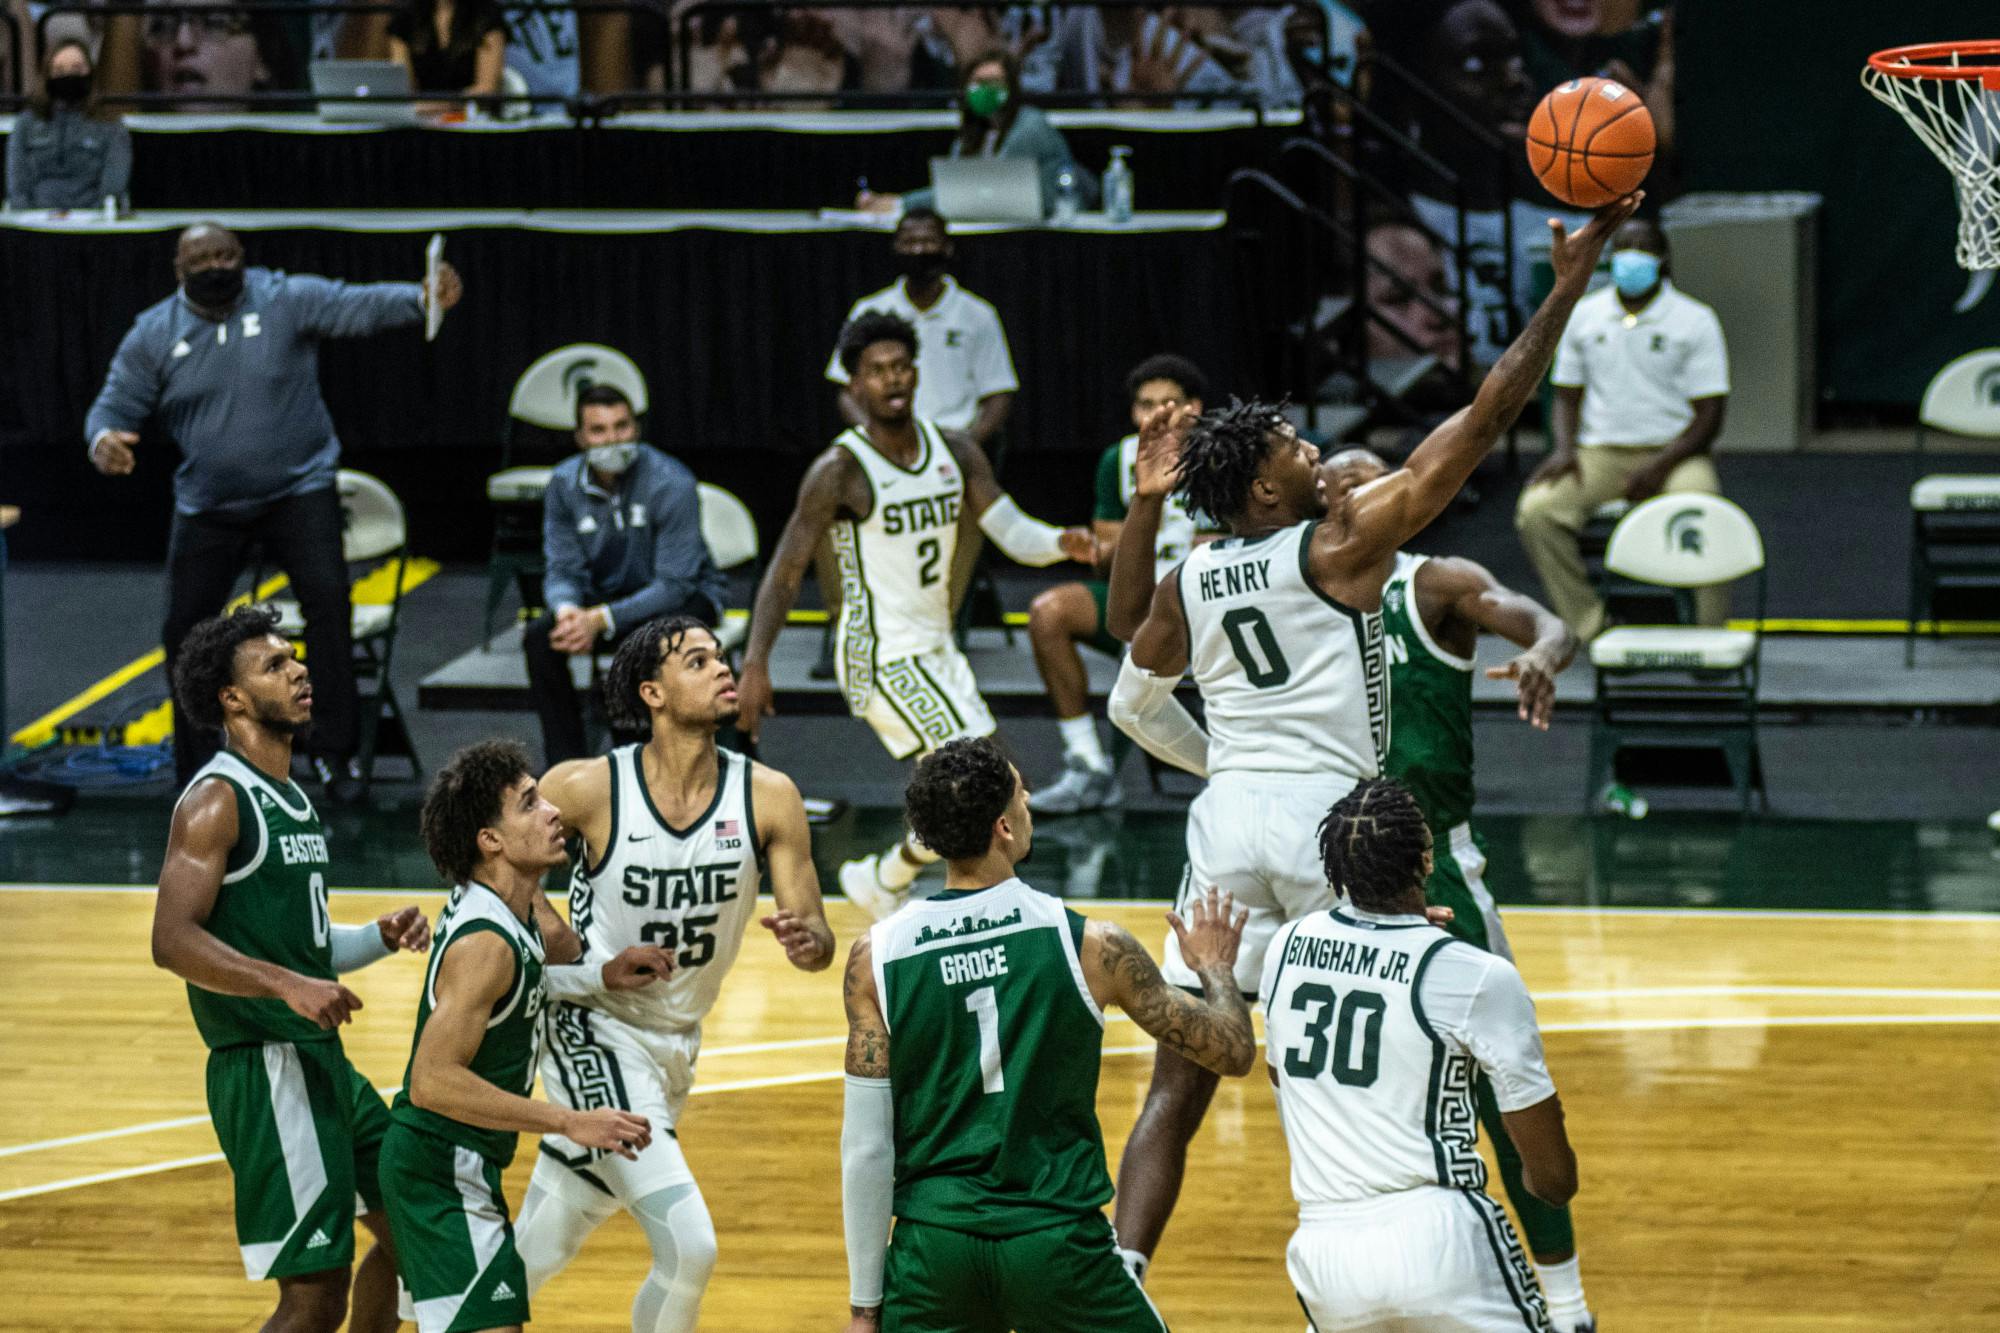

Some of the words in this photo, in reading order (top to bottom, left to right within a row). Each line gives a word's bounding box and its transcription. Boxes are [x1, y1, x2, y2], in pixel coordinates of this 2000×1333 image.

[883, 491, 961, 536] STATE
[917, 537, 940, 588] 2
[1200, 559, 1271, 602] HENRY
[1221, 606, 1291, 690] 0
[278, 833, 330, 865] EASTER
[309, 872, 331, 949] 0
[622, 861, 742, 910] STATE
[939, 944, 1009, 986] GROCE
[1287, 935, 1380, 978] BINGHAM
[1379, 950, 1411, 985] JR.
[965, 985, 1005, 1095] 1
[1283, 981, 1388, 1089] 30
